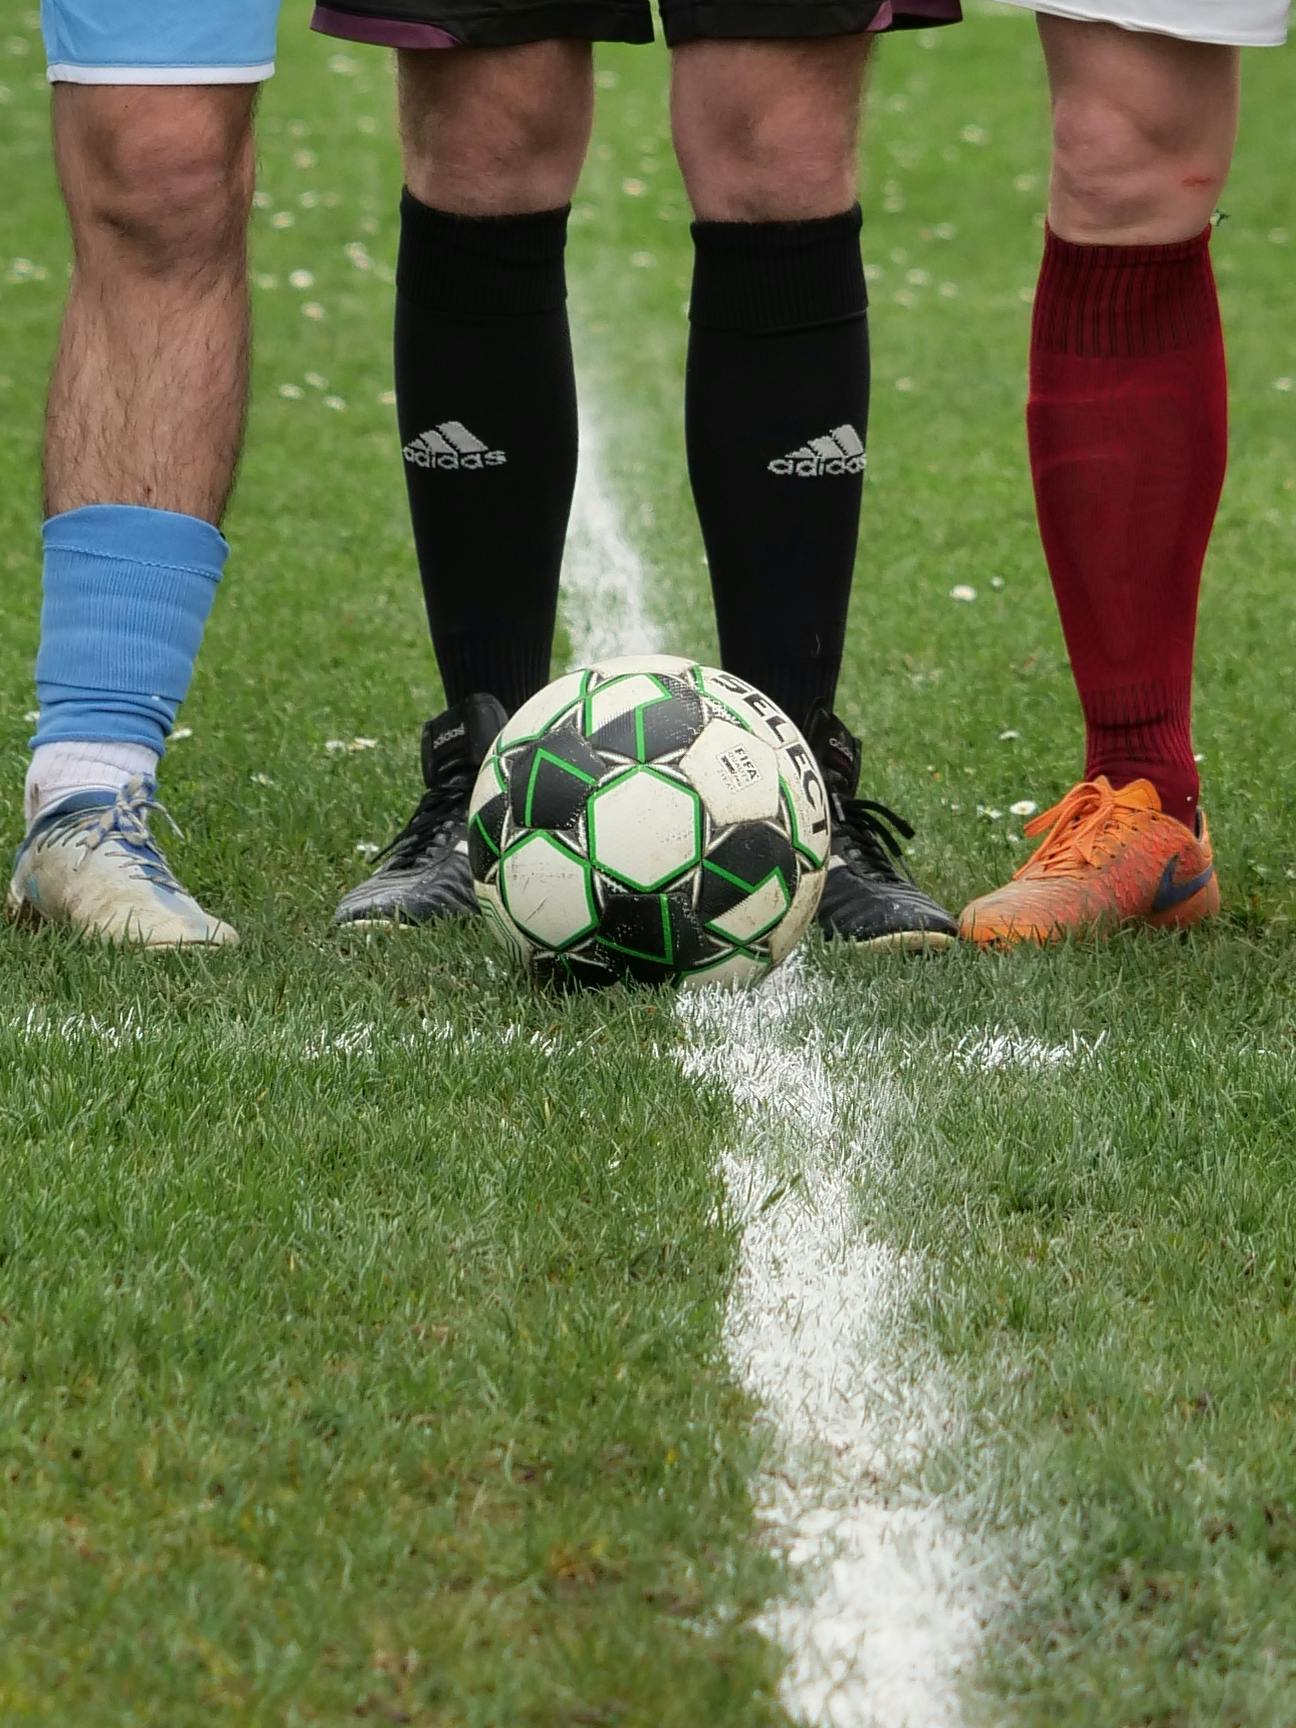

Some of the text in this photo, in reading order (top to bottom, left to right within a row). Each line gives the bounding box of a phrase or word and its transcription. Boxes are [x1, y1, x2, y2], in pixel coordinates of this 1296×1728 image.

[404, 446, 508, 470] adidas
[710, 673, 829, 837] SELECT
[734, 747, 758, 781] FIFA
